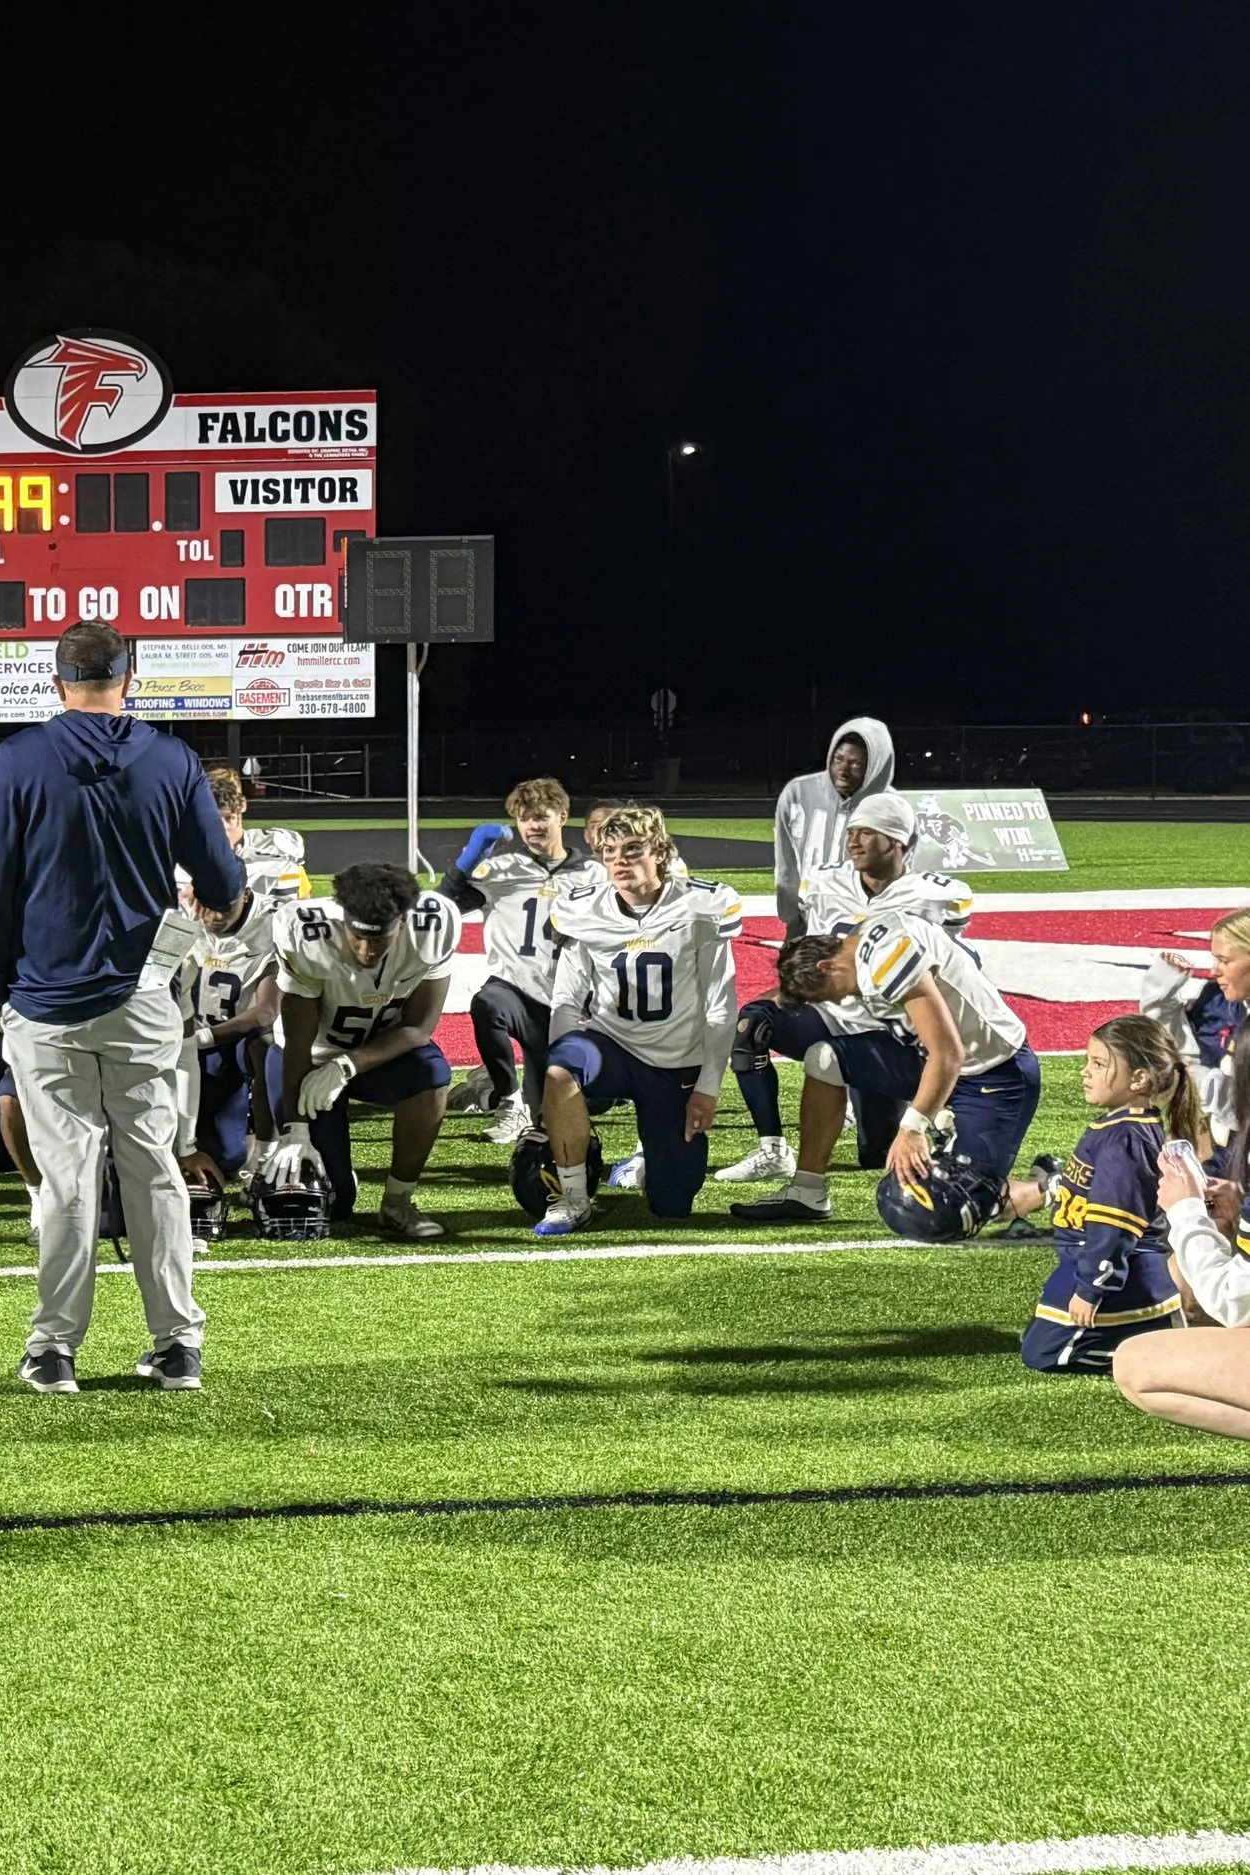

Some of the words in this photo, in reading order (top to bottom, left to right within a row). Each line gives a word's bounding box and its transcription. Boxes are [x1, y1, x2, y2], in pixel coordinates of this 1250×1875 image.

[198, 409, 369, 444] FALCONS
[229, 477, 358, 505] VISITOR
[176, 540, 214, 562] TOL
[28, 587, 66, 622] TO
[78, 586, 119, 621] GO
[139, 585, 180, 620] ON
[275, 583, 333, 618] QTR
[287, 643, 309, 654] COME
[310, 643, 327, 654] JOIN
[329, 643, 344, 653] OUR
[30, 681, 58, 694] Aire
[342, 679, 351, 688] &
[3, 697, 38, 705] HVAC
[135, 698, 175, 709] ROOFING
[184, 697, 230, 708] WINDOWS
[238, 691, 287, 705] BASEMENT
[295, 692, 370, 702] thebasementbars.com
[299, 702, 367, 715] 330-678-4800
[962, 801, 1025, 822] PINNED
[1023, 801, 1048, 821] TO
[993, 826, 1035, 847] WIN!
[296, 906, 333, 942] 56
[858, 924, 890, 965] 28
[611, 951, 674, 1023] 10
[1091, 1259, 1124, 1291] 2
